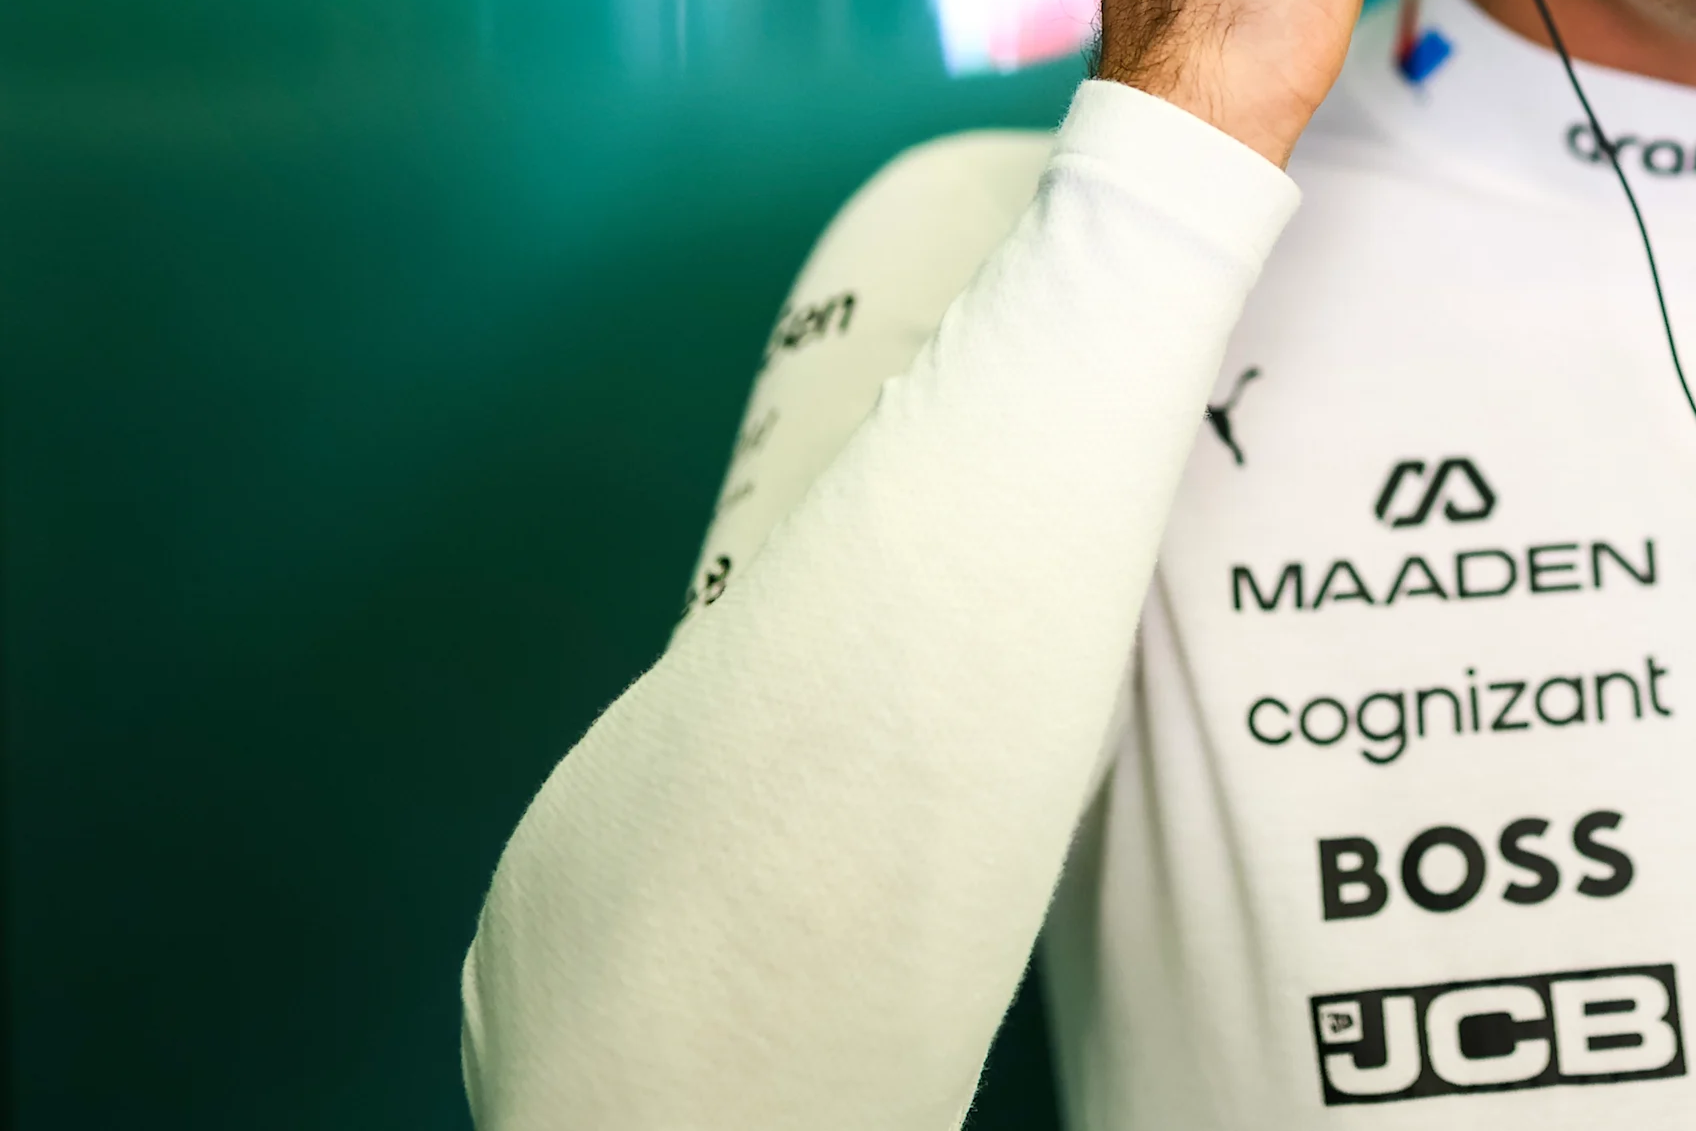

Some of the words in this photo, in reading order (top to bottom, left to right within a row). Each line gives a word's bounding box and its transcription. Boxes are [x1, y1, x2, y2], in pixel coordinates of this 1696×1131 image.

[1230, 538, 1657, 611] MAADEN
[1247, 656, 1673, 765] cognizant
[1317, 809, 1635, 921] BOSS
[1321, 972, 1679, 1097] JCB
